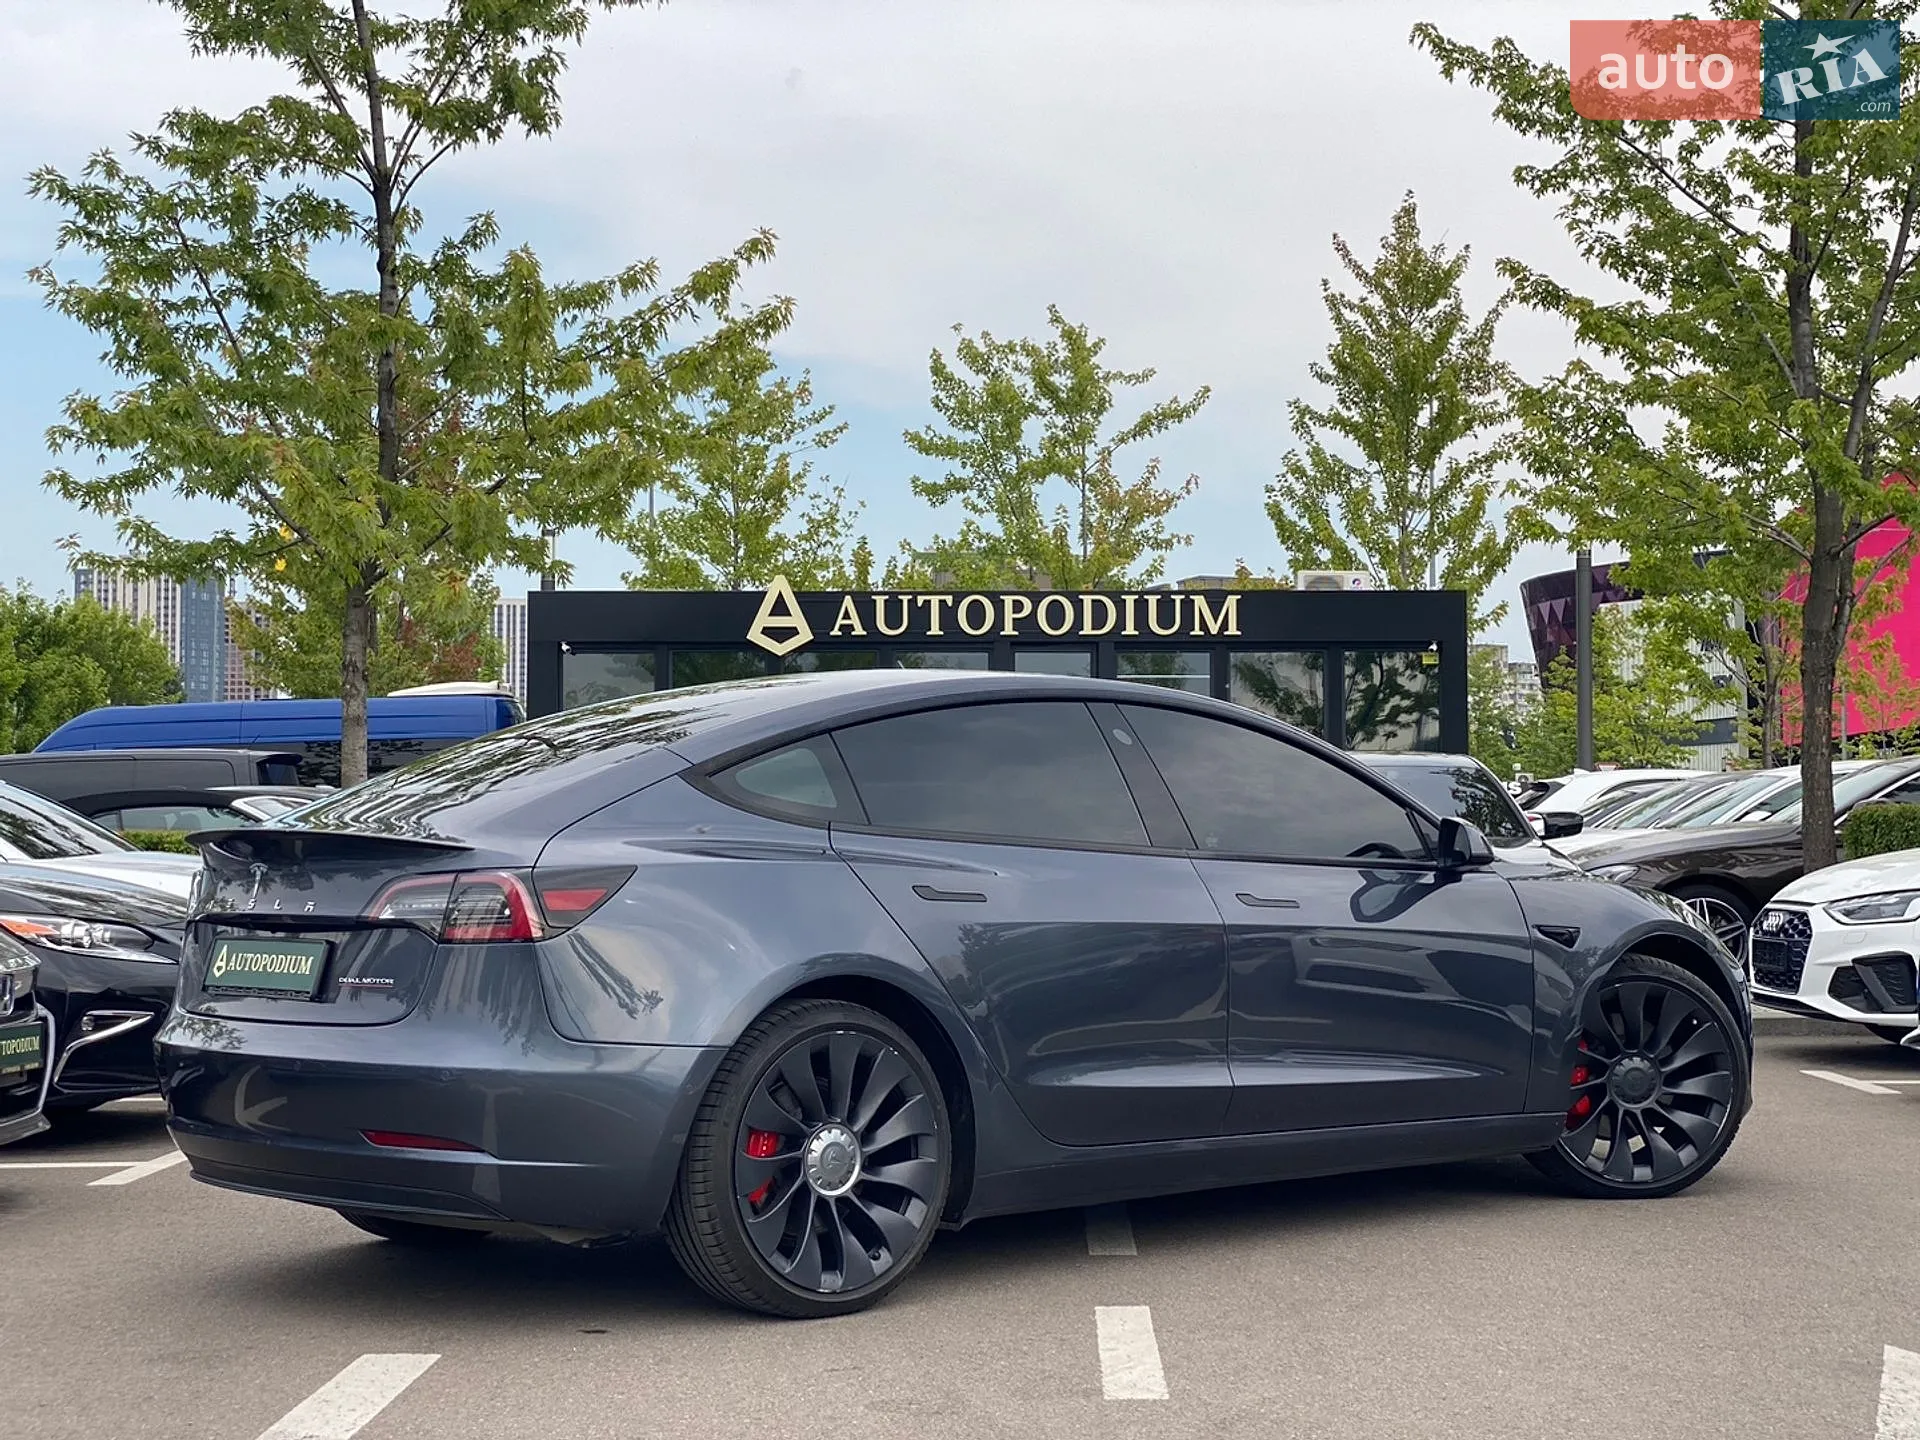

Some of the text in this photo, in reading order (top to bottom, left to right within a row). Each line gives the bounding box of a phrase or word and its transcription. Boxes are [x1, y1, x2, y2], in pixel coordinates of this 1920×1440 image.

[829, 594, 1242, 637] AUTOPODIUM
[226, 952, 315, 975] AUTOPODIUM
[338, 976, 395, 985] DUAL MOTOR
